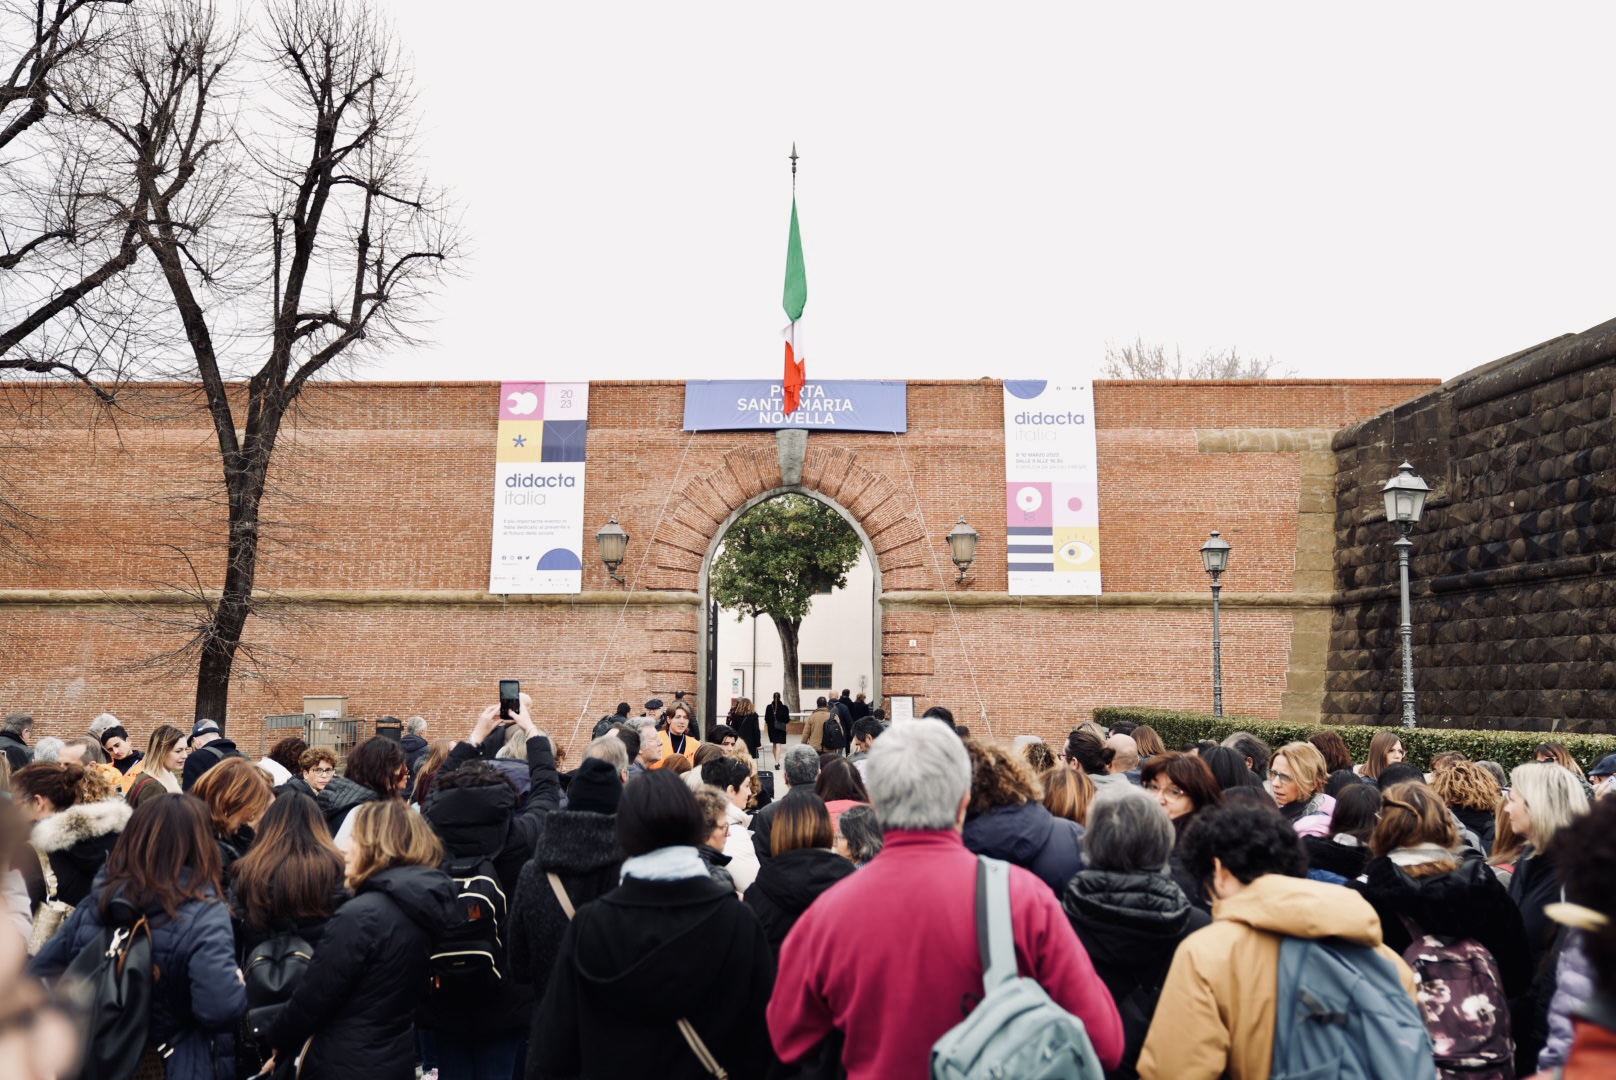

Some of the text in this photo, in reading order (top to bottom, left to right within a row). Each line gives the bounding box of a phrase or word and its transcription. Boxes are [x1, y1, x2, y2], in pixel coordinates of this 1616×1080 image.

[560, 389, 573, 399] 20
[770, 384, 825, 398] PTA
[560, 399, 572, 409] 23
[737, 398, 854, 412] SANT MARIA
[759, 411, 836, 425] NOVELLA
[1014, 411, 1085, 425] didacta
[1015, 427, 1057, 441] italia
[505, 472, 576, 488] didacta
[504, 489, 547, 506] italia
